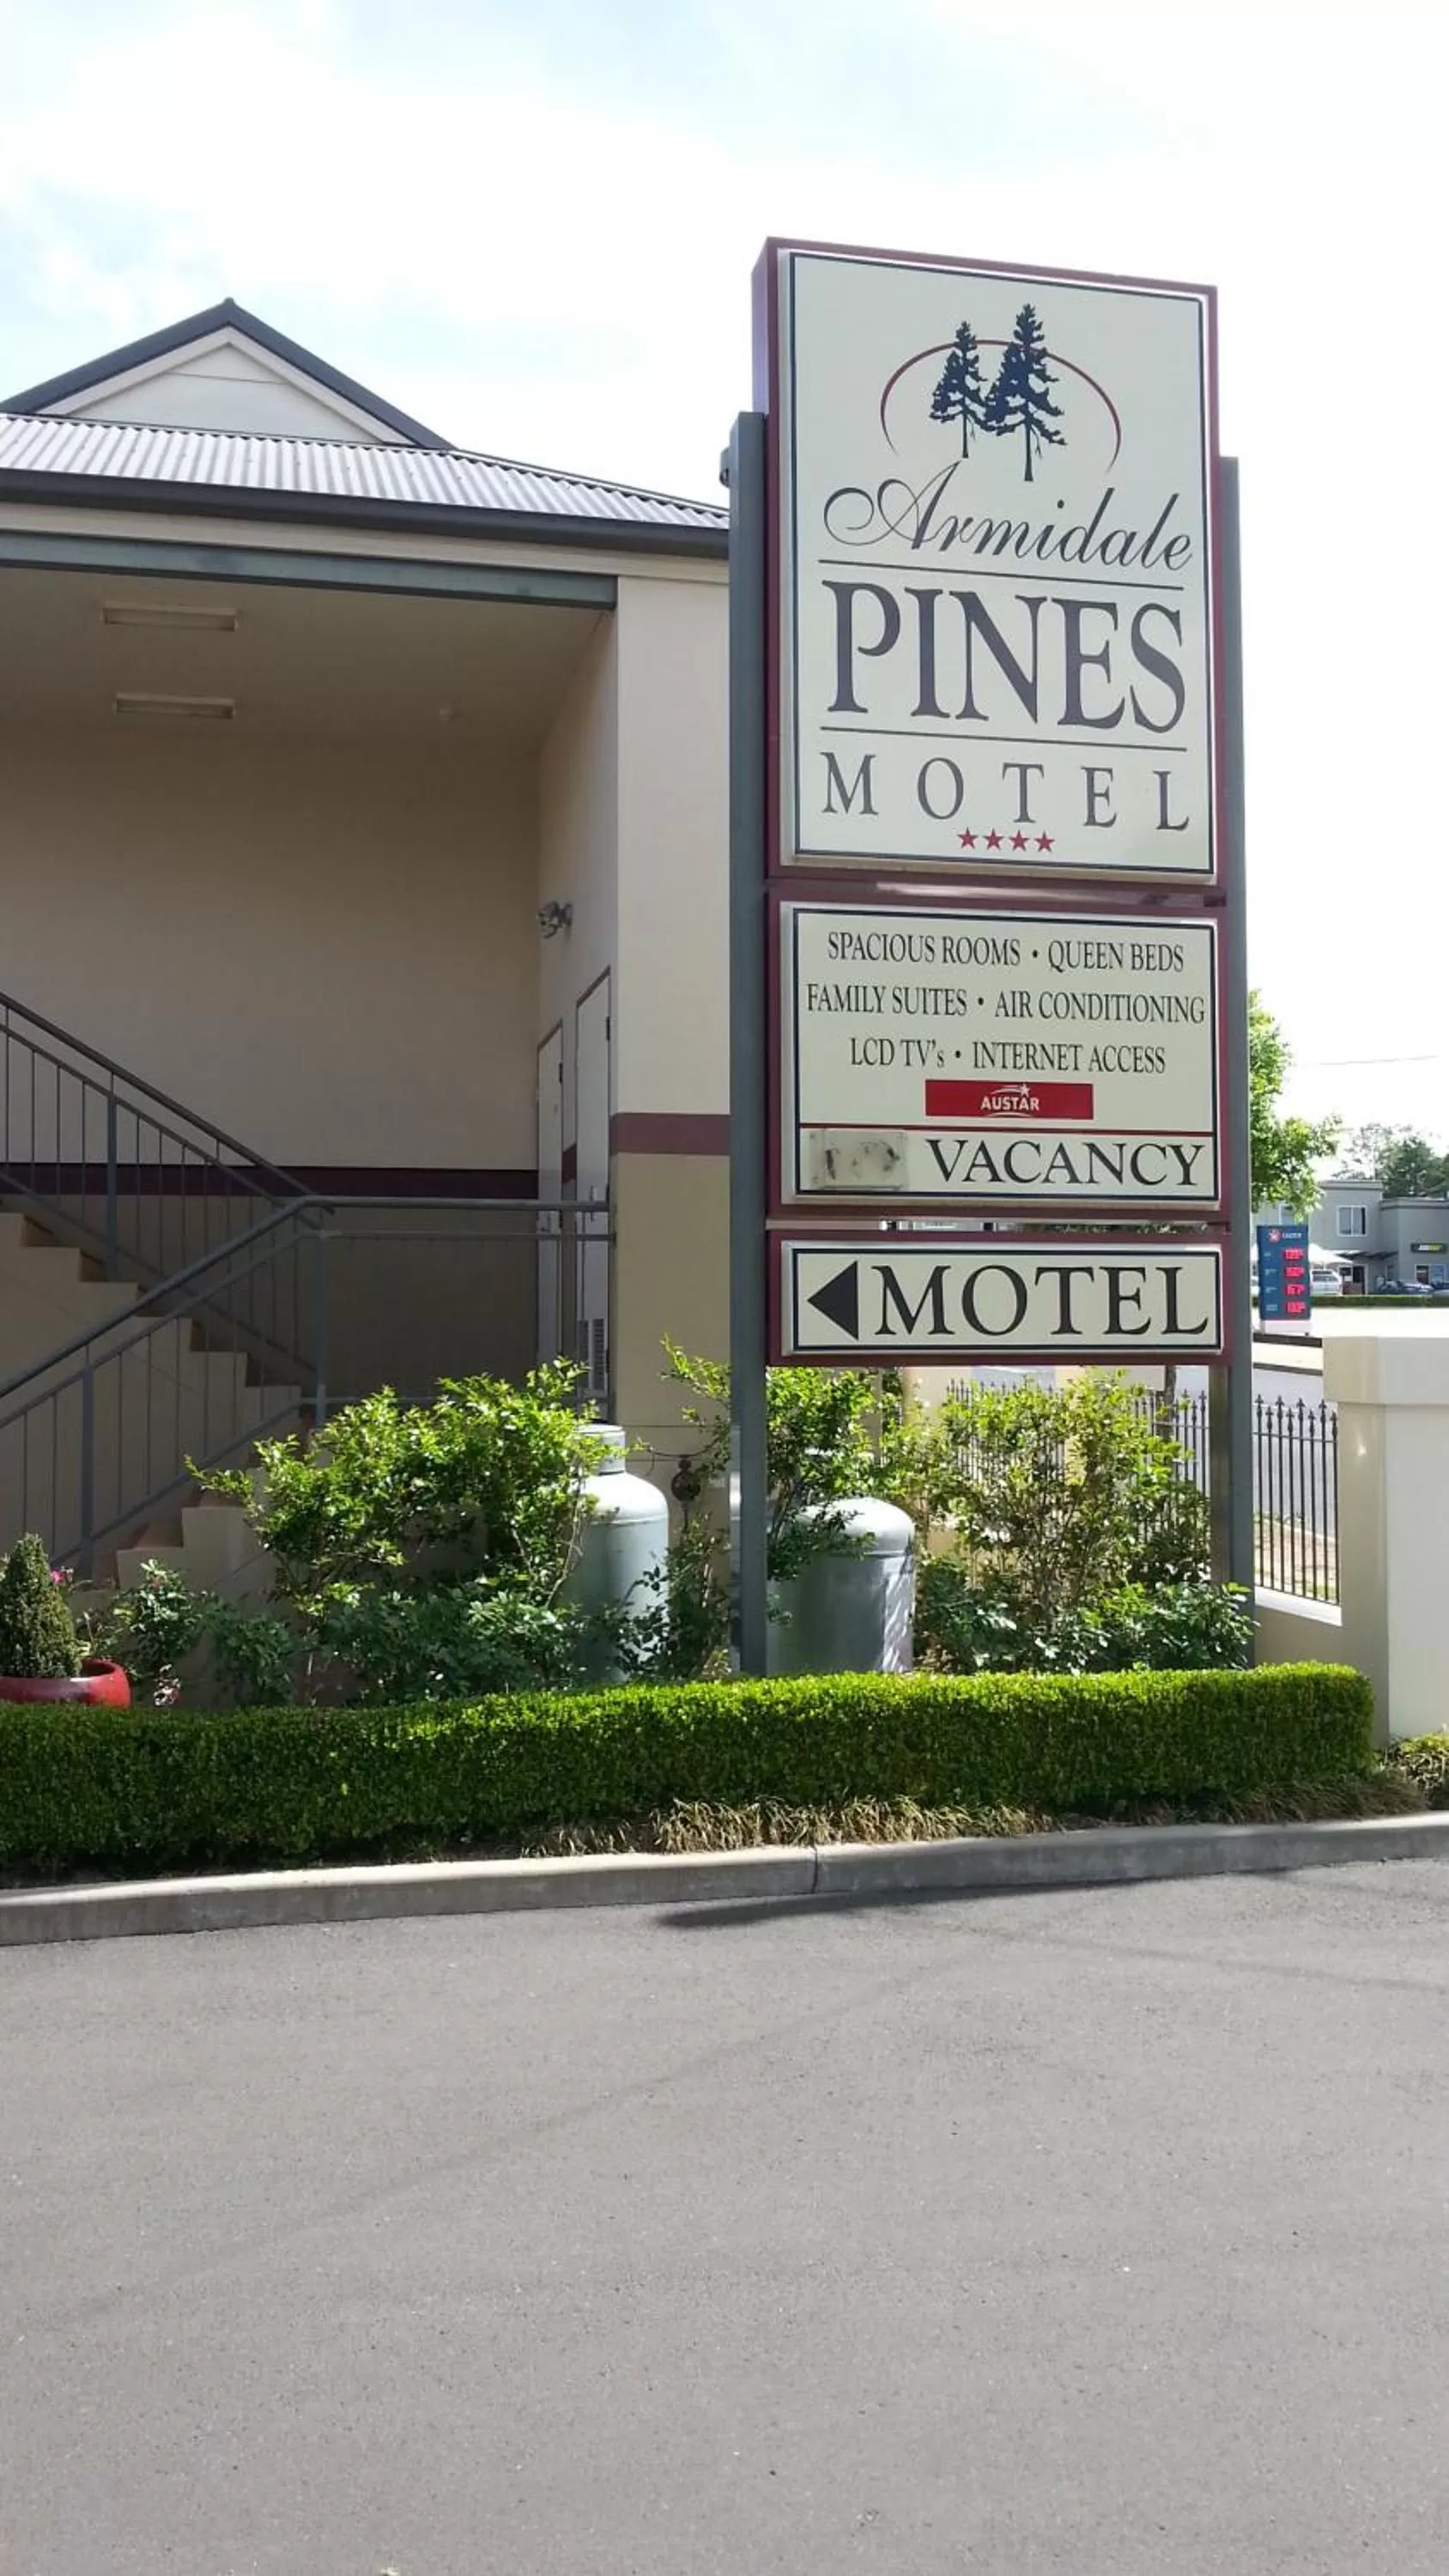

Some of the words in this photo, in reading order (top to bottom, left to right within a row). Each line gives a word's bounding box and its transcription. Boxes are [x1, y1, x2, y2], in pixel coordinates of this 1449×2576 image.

[823, 460, 1192, 571] Armidale
[822, 580, 1185, 733] PINES
[821, 751, 1189, 831] MOTEL
[828, 932, 935, 963] SPACIOUS
[943, 936, 1021, 965] ROOMS
[1048, 940, 1124, 973] QUEEN
[1131, 943, 1184, 972] BEDS
[807, 983, 886, 1013] FAMILY
[893, 987, 967, 1017] SUITES
[995, 991, 1032, 1018] AIR
[1039, 994, 1205, 1024] CONDITIONING
[851, 1037, 894, 1066] LCD
[973, 1042, 1083, 1072] INTERNET
[1088, 1045, 1166, 1073] ACCESS
[980, 1096, 1040, 1111] AUSTAR
[925, 1139, 1205, 1187] VACANCY
[870, 1265, 1209, 1336] MOTEL
